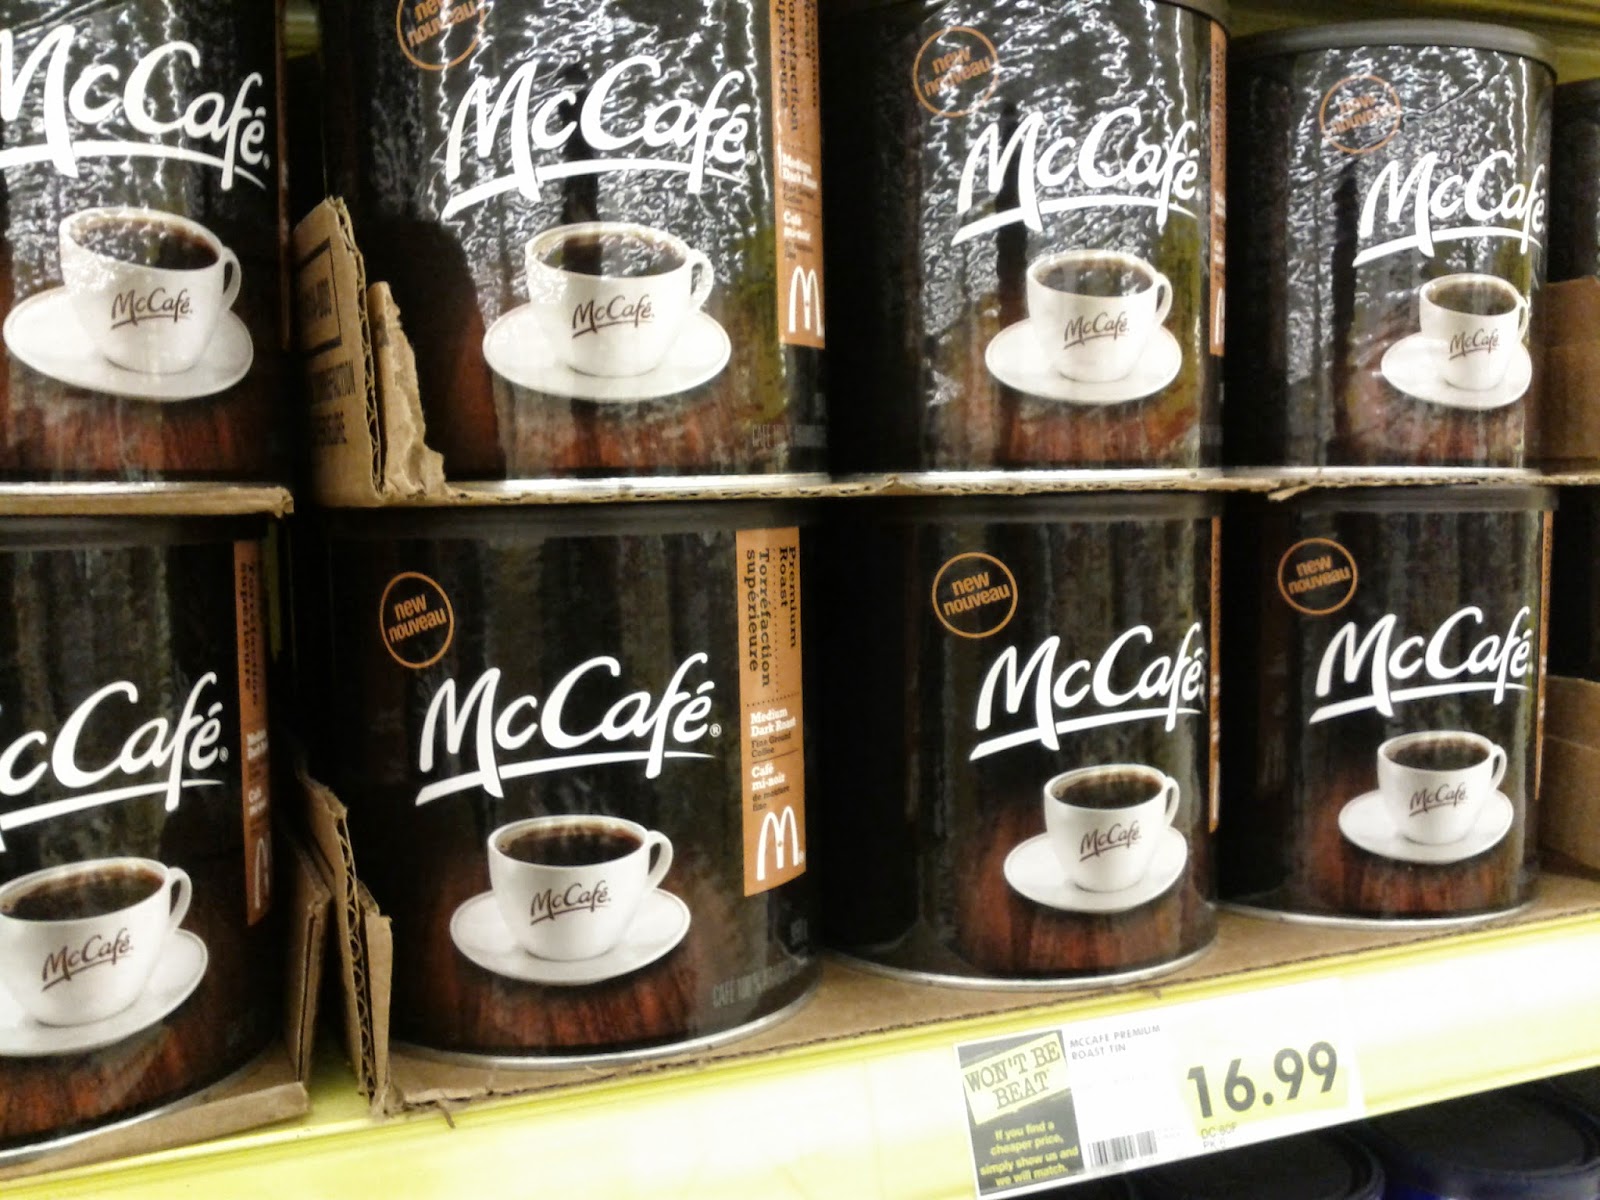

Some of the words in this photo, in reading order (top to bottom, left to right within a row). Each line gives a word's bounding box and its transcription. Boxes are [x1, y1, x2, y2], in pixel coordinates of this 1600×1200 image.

[407, 1, 476, 47] noueau
[0, 25, 266, 190] McCafé
[442, 56, 752, 218] McCafé
[951, 106, 1200, 246] McCafé
[1352, 150, 1545, 267] McCafé
[111, 287, 193, 330] McCafé
[572, 294, 654, 338] McCafé
[1063, 311, 1130, 350] McCafé
[1449, 327, 1500, 360] McCafé
[779, 546, 789, 607] Roast
[951, 571, 991, 597] new
[1288, 565, 1351, 595] nouveau
[1296, 555, 1333, 577] new
[394, 594, 428, 620] new
[744, 549, 760, 673] supérieure
[759, 548, 772, 687] Torréfaction
[788, 546, 798, 648] Premium
[943, 584, 1011, 617] nouveau
[388, 606, 448, 643] nouveau
[1309, 606, 1532, 724] McCafé
[969, 622, 1203, 761] McCafé
[415, 652, 715, 806] McCafé
[751, 707, 788, 725] Medium
[0, 671, 224, 830] cCafé
[752, 761, 774, 778] Café
[1409, 783, 1468, 816] McCafé
[1079, 820, 1142, 862] McCafé
[529, 880, 612, 925] McCafé
[42, 927, 134, 992] McCafé
[1069, 1033, 1110, 1049] MCCAFE
[1114, 1024, 1161, 1041] PREMIUM
[1071, 1044, 1106, 1060] ROAST
[1108, 1042, 1127, 1054] TIN
[964, 1050, 1028, 1093] WON'T
[1030, 1040, 1061, 1069] BE
[1187, 1041, 1337, 1118] 16.99
[992, 1070, 1050, 1110] BEAT
[990, 1140, 1032, 1156] cheaper
[1004, 1127, 1024, 1141] you
[1026, 1120, 1046, 1135] find
[1047, 1121, 1055, 1131] a
[980, 1160, 1014, 1176] simply
[1015, 1155, 1043, 1168] show
[1045, 1152, 1058, 1162] us
[1060, 1145, 1079, 1159] and
[995, 1176, 1012, 1187] we
[1013, 1169, 1032, 1182] will
